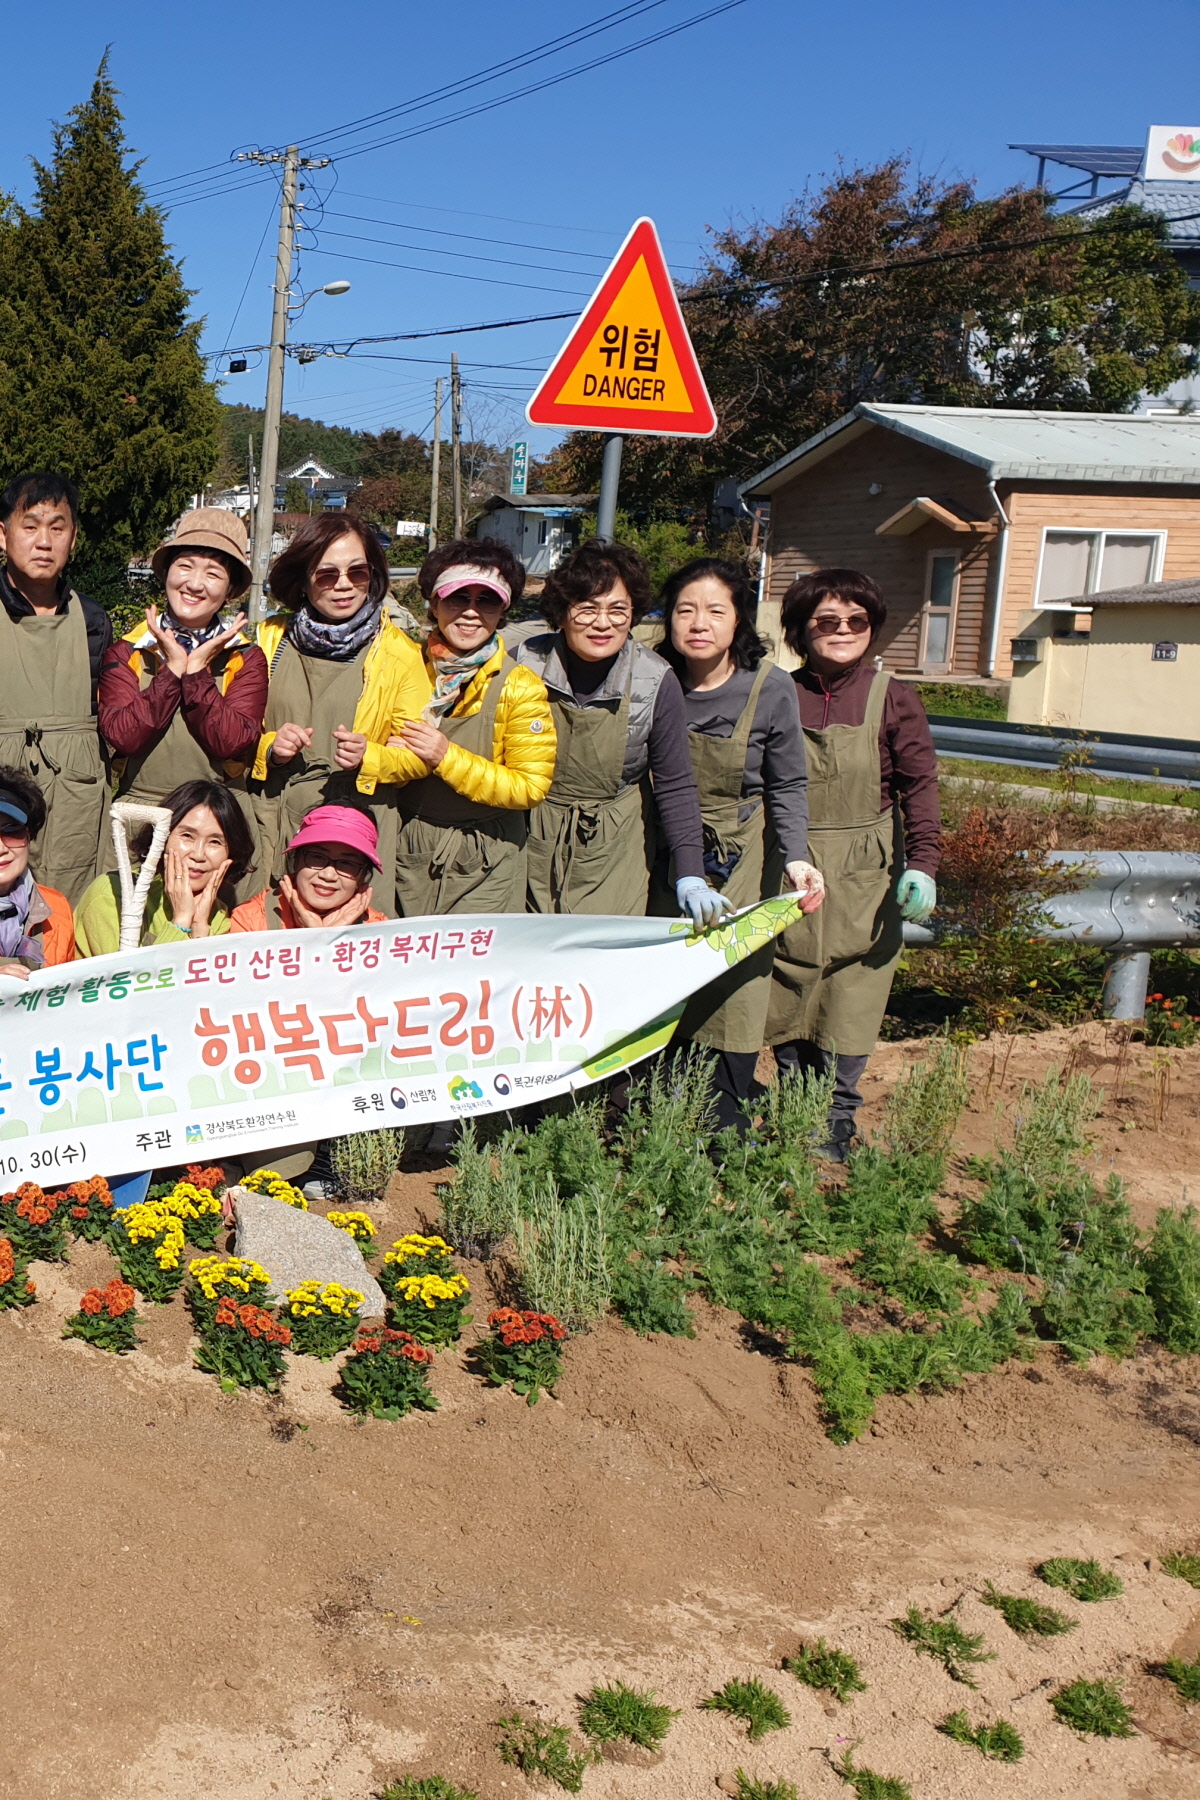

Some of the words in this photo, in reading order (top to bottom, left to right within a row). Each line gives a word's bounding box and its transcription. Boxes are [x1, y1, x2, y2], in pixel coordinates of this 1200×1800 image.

[599, 324, 661, 372] 위험
[583, 373, 666, 402] DANGER
[1155, 650, 1176, 659] 11-9
[13, 982, 71, 1012] 체험
[77, 967, 176, 1003] 활동으로
[184, 952, 237, 984] 도민
[248, 946, 301, 980] 산림
[332, 937, 381, 972] 환경
[389, 929, 494, 964] 복지구현
[28, 1033, 168, 1106] 봉사단
[351, 1092, 385, 1114] 후원
[410, 1088, 437, 1103] 산림청
[135, 1129, 172, 1152] 주관
[205, 1109, 297, 1135] 경상북도환경연수원
[30, 1141, 87, 1169] 30(수)
